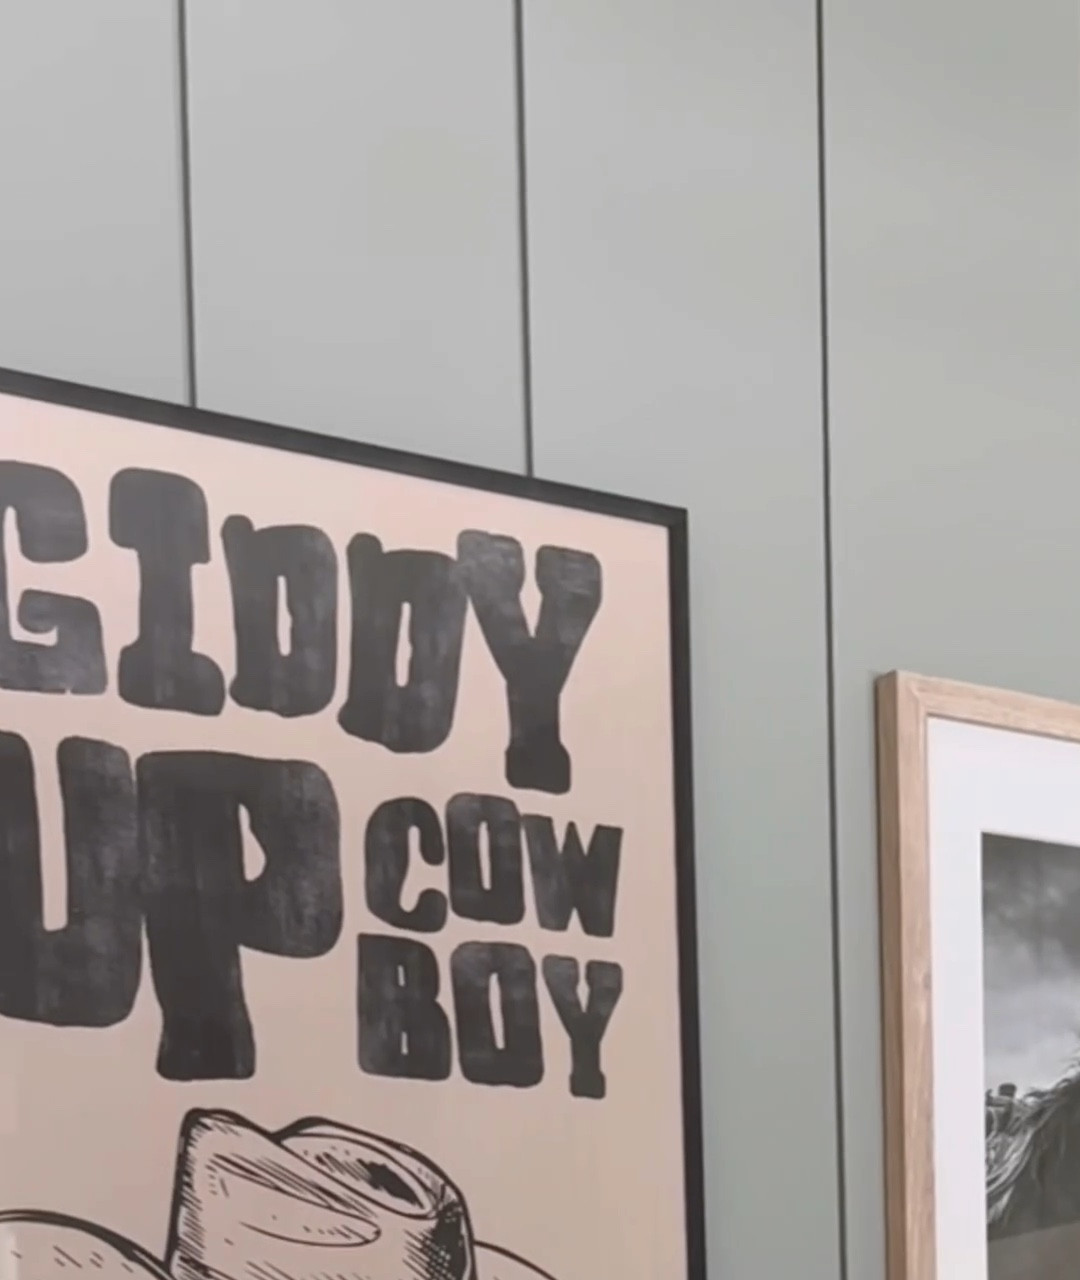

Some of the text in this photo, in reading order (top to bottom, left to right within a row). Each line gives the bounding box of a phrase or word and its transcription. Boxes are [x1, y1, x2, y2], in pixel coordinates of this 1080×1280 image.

[0, 460, 603, 794] GIDDY
[0, 730, 344, 1081] UP
[365, 793, 623, 938] COW
[357, 933, 624, 1099] BOY
